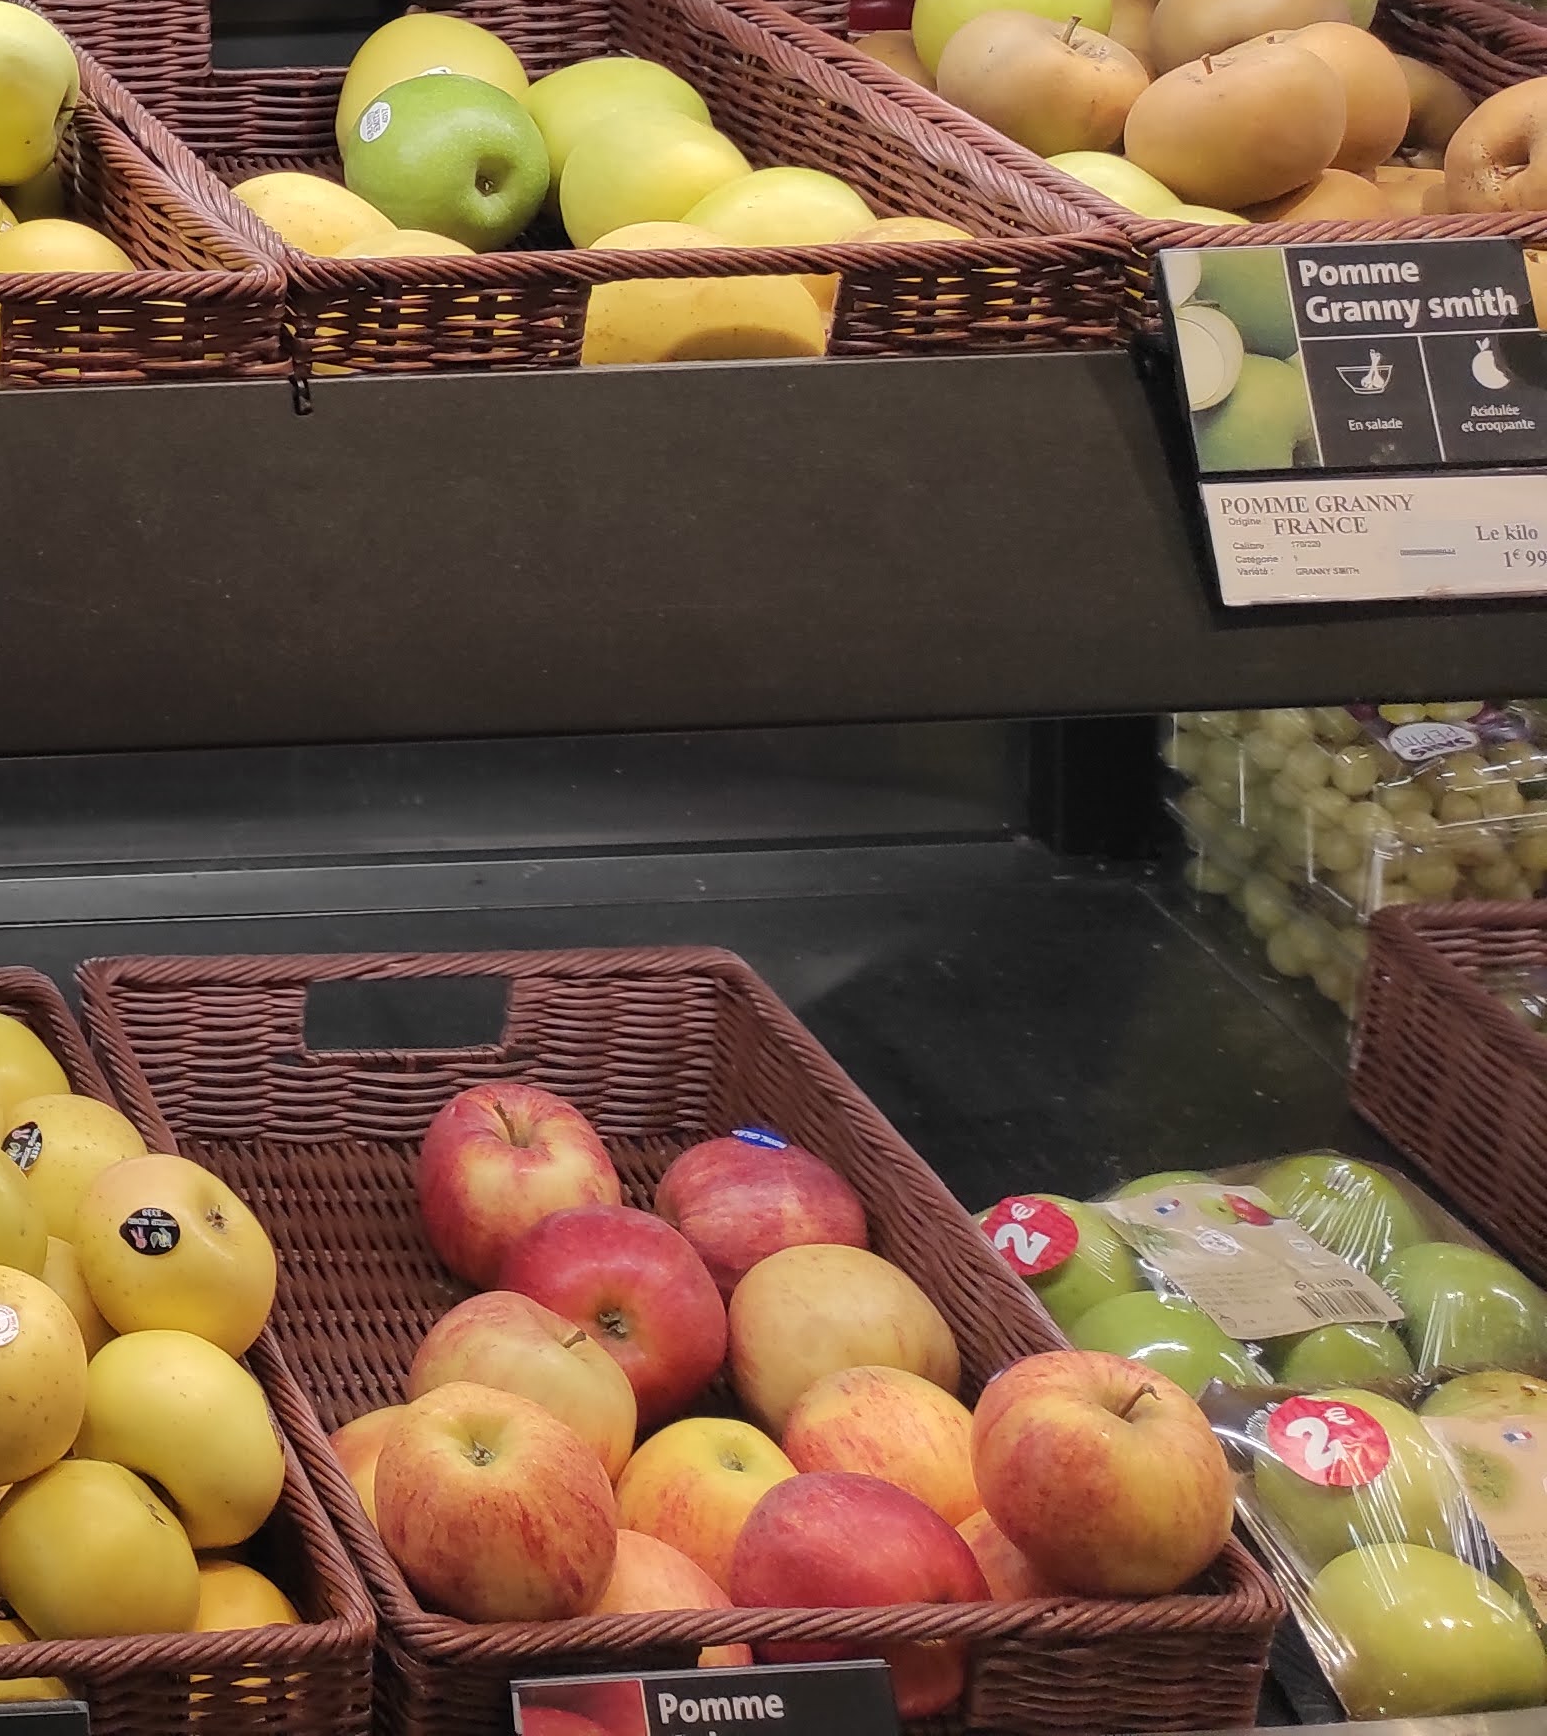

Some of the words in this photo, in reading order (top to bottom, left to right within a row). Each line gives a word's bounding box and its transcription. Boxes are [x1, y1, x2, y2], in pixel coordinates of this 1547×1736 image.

[1298, 258, 1420, 288] Pomme
[1305, 295, 1420, 329] Granny
[1427, 286, 1520, 320] smith
[1470, 403, 1521, 417] Acidulée
[1348, 418, 1363, 432] En
[1365, 417, 1404, 431] salade
[1461, 422, 1473, 433] et
[1474, 418, 1536, 434] croquante
[1220, 496, 1308, 515] POMME
[1314, 493, 1415, 514] GRANNY
[1273, 515, 1369, 536] FRANCE
[1475, 524, 1500, 542] Le
[1505, 523, 1539, 541] kilo
[657, 1690, 786, 1724] Pomme
